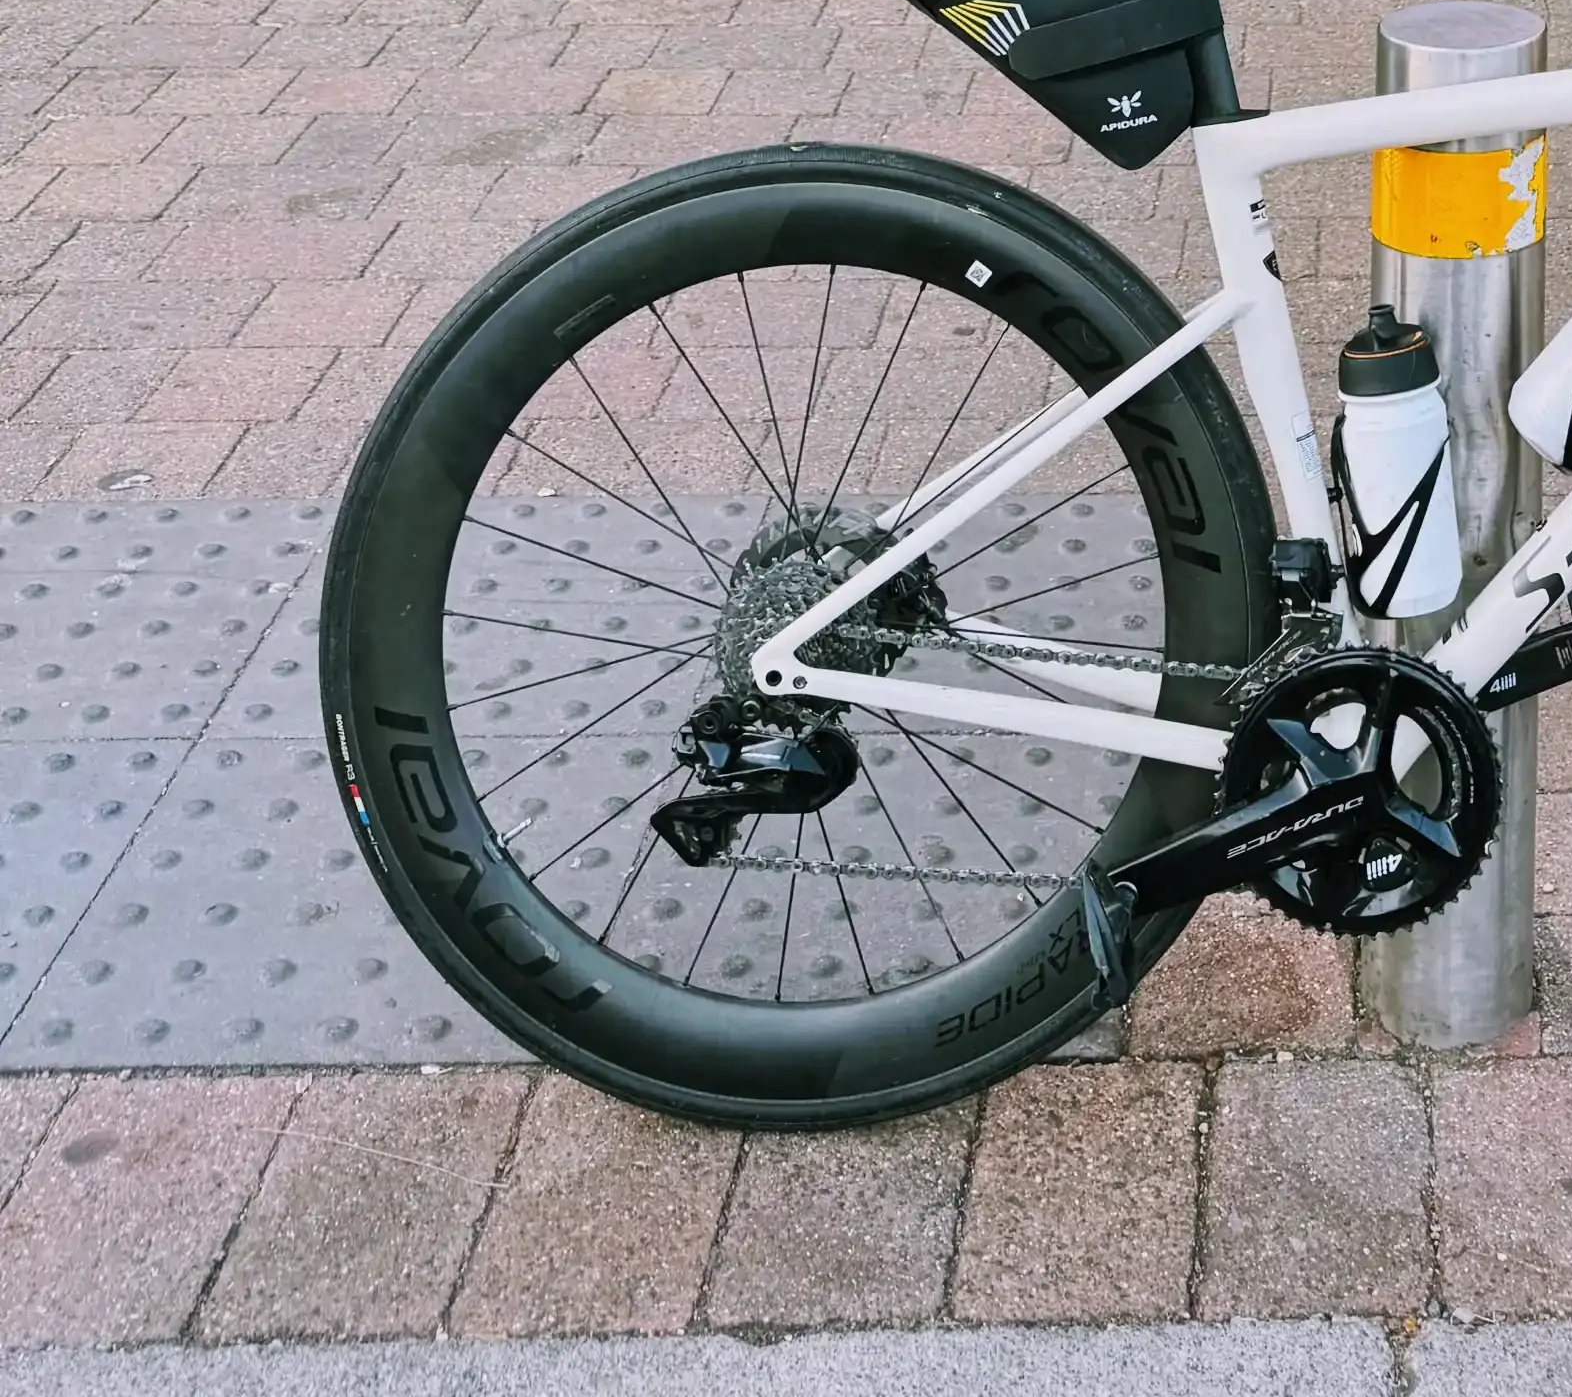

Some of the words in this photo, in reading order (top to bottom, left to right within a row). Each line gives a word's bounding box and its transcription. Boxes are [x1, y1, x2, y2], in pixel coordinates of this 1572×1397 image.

[1100, 114, 1158, 132] APIDURA
[374, 705, 613, 1012] roval
[1226, 795, 1364, 860] DURA-ACE
[935, 932, 1090, 1047] APIDE
